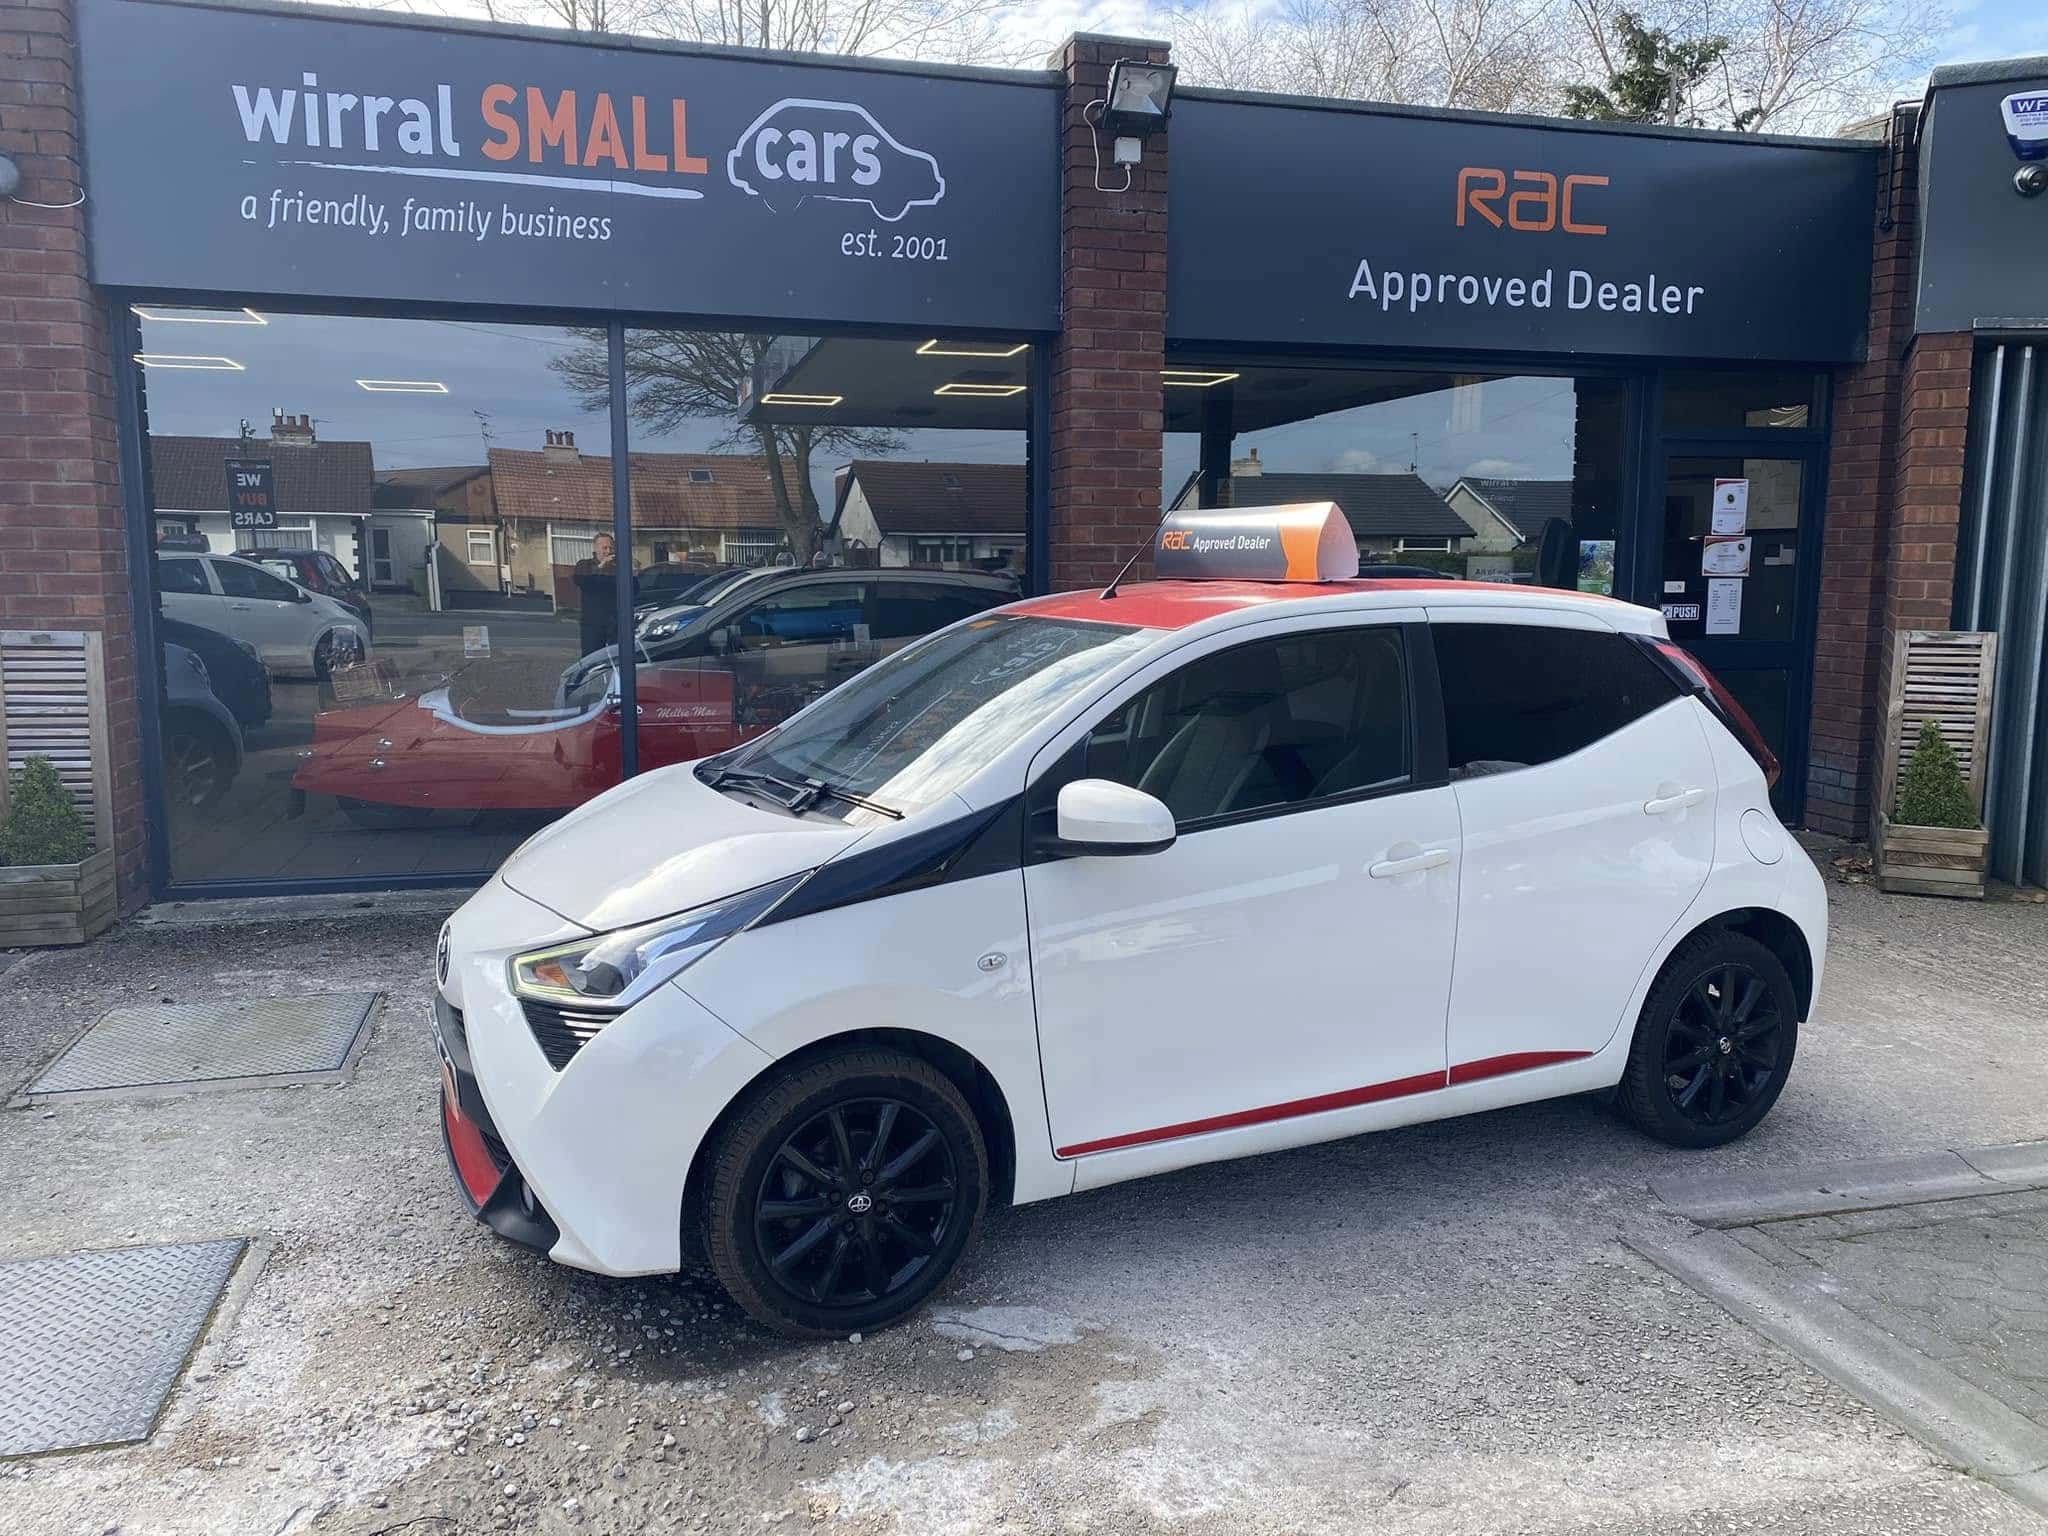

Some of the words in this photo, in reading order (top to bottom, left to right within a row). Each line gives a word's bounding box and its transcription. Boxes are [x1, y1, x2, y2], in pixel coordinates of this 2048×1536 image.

[231, 72, 460, 158] wirral
[479, 83, 708, 175] SMALL
[754, 126, 882, 186] cars
[240, 194, 258, 222] a
[267, 189, 391, 236] friendly,
[401, 197, 493, 243] family
[501, 205, 613, 242] business
[841, 229, 883, 258] est.
[892, 235, 949, 262] 2001
[1348, 258, 1553, 314] Approved
[1568, 270, 1706, 315] Dealer
[1193, 535, 1236, 553] Approved
[1237, 535, 1271, 550] Dealer
[1673, 606, 1697, 618] PUSH
